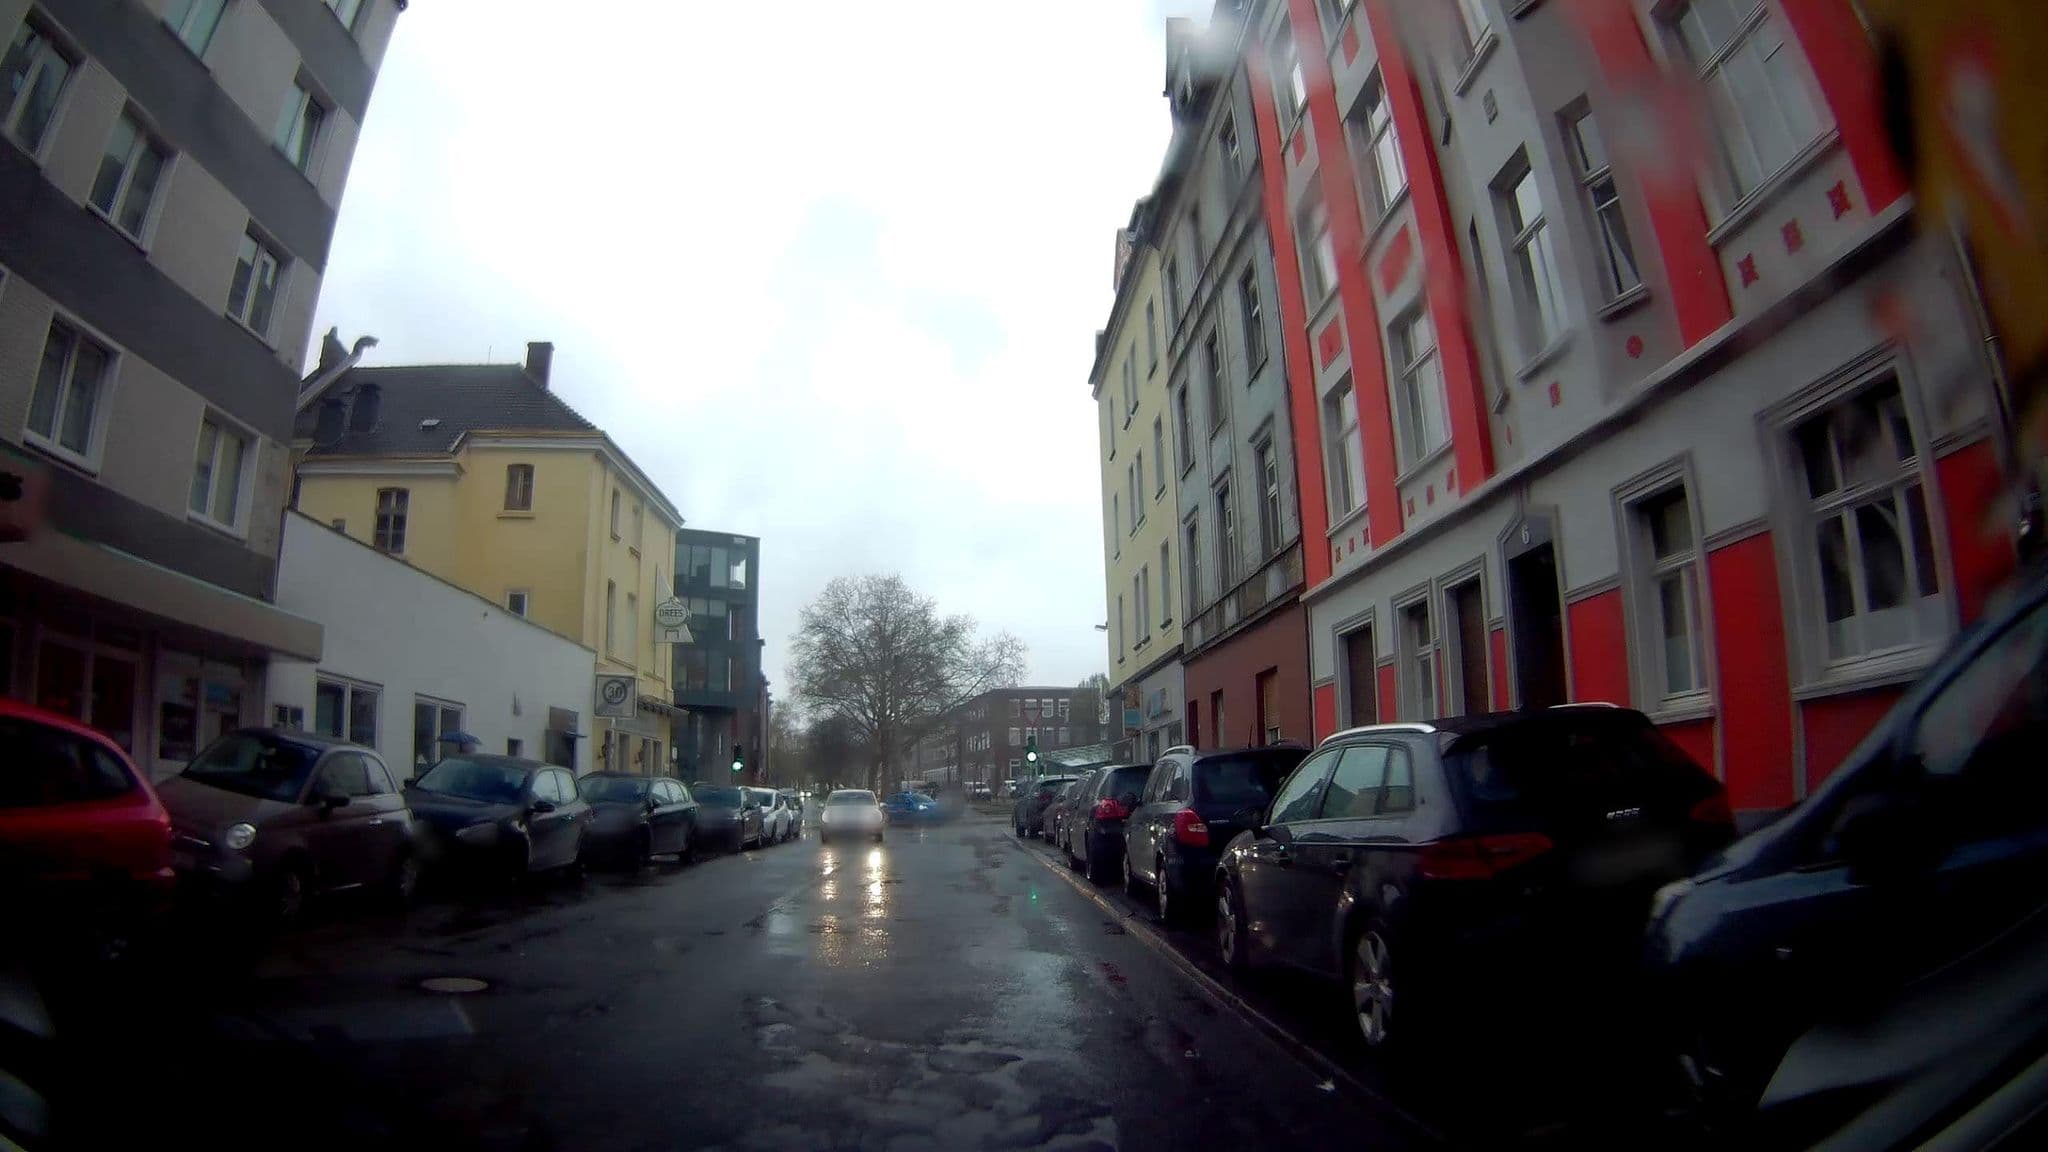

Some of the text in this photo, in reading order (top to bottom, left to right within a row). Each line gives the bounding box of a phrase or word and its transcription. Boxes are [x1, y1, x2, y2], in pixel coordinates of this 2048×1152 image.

[1521, 525, 1530, 544] 6
[660, 608, 683, 617] DREES
[608, 686, 622, 698] 30
